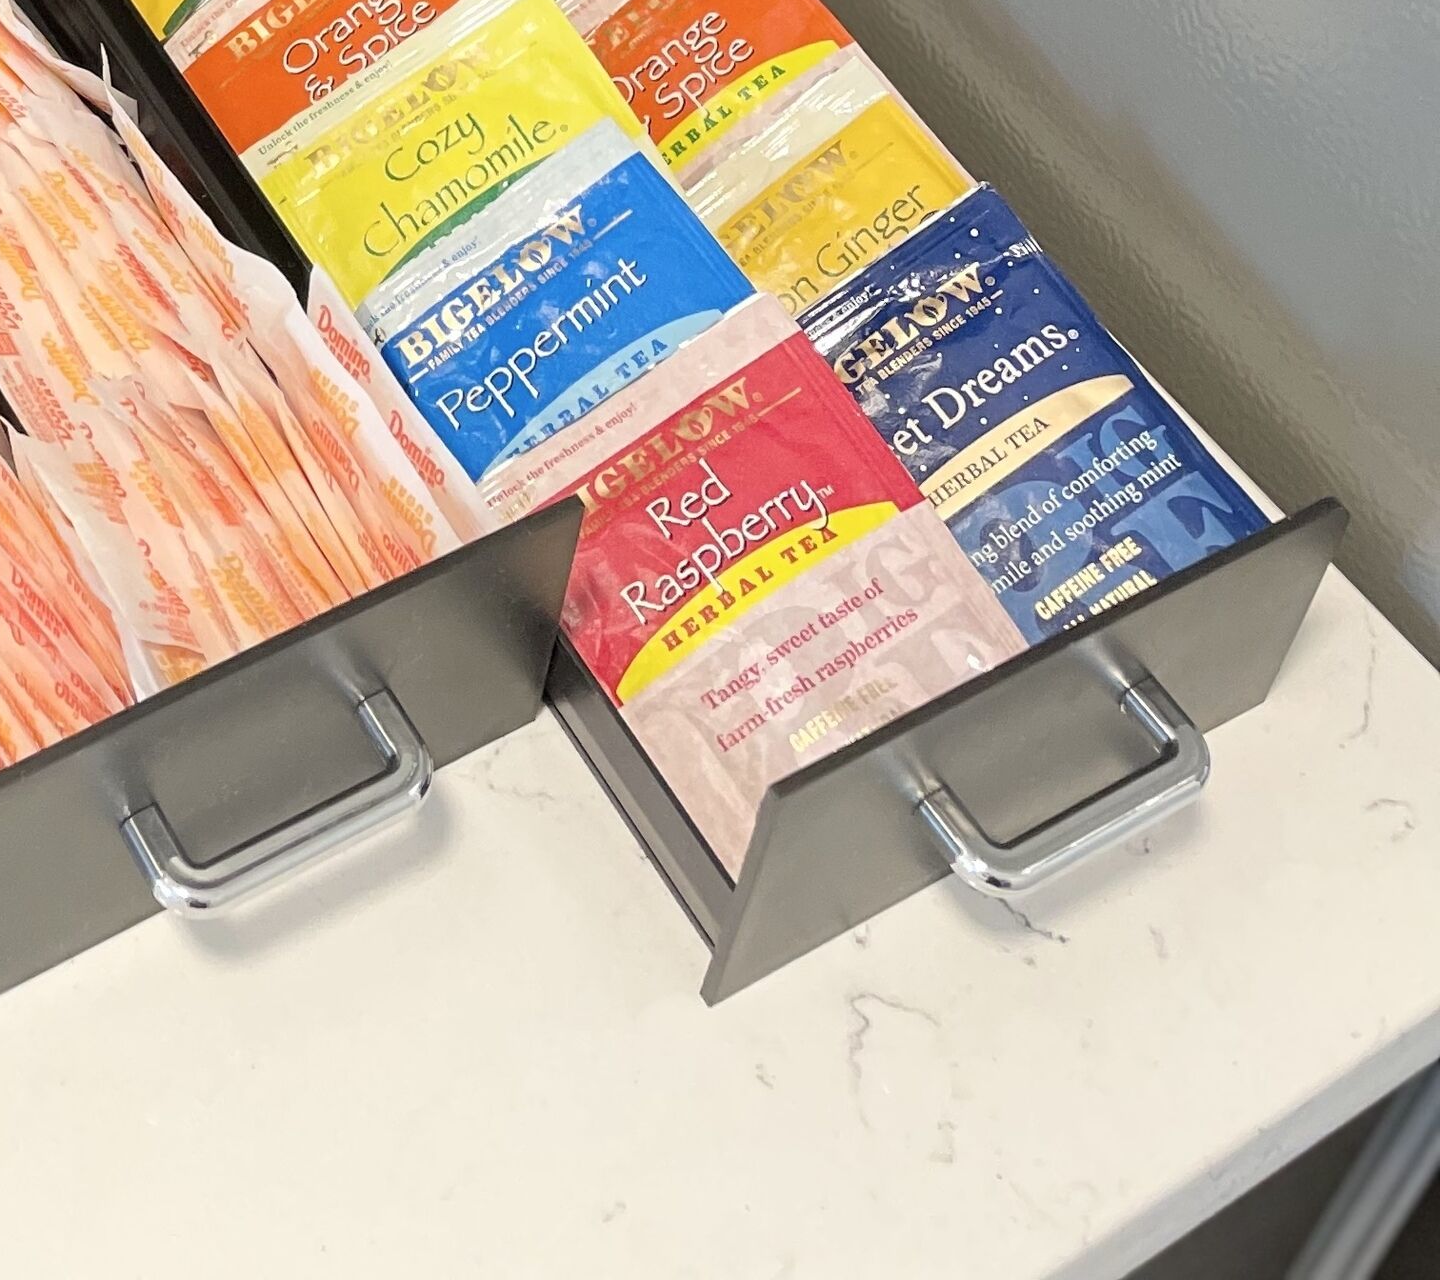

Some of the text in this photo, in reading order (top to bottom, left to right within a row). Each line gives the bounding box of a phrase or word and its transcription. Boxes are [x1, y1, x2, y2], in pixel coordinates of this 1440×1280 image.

[305, 0, 437, 103] & Spice
[655, 37, 755, 120] Spice
[293, 115, 311, 132] the
[384, 112, 486, 182] Cozy
[662, 63, 786, 166] ERBAL TEA
[363, 113, 557, 258] Chamomile
[815, 184, 929, 277] Ginger
[393, 204, 586, 369] BIGELOW
[427, 341, 464, 371] FAMILY
[466, 322, 487, 342] TEA
[537, 256, 569, 285] SINCE
[833, 262, 983, 385] GELOW
[317, 304, 372, 384] Domino
[436, 258, 647, 431] Peppermint
[615, 338, 668, 381] TEA
[878, 338, 933, 381] BLENDERS
[932, 314, 967, 340] SINCE
[965, 297, 992, 317] 1945
[921, 321, 1070, 431] Dreams
[389, 409, 446, 493] Domino
[526, 467, 545, 486] the
[579, 376, 755, 517] IGELOW
[700, 429, 732, 454] SINCE
[927, 416, 1051, 509] HERBAL TEA
[989, 430, 1158, 549] blend of comforting
[646, 459, 733, 542] Red
[1031, 531, 1066, 566] and
[1064, 482, 1144, 542] soothing
[1137, 453, 1183, 489] mint
[620, 479, 830, 626] Raspberry
[661, 527, 840, 652] HERBAL TEA
[1034, 562, 1105, 620] CAFFEINE
[1100, 536, 1143, 573] FREE
[701, 577, 885, 710] Tangy, sweet taste of
[716, 675, 815, 752] farm-fresh
[815, 607, 919, 683] raspberries
[789, 695, 859, 753] CAFFEINE
